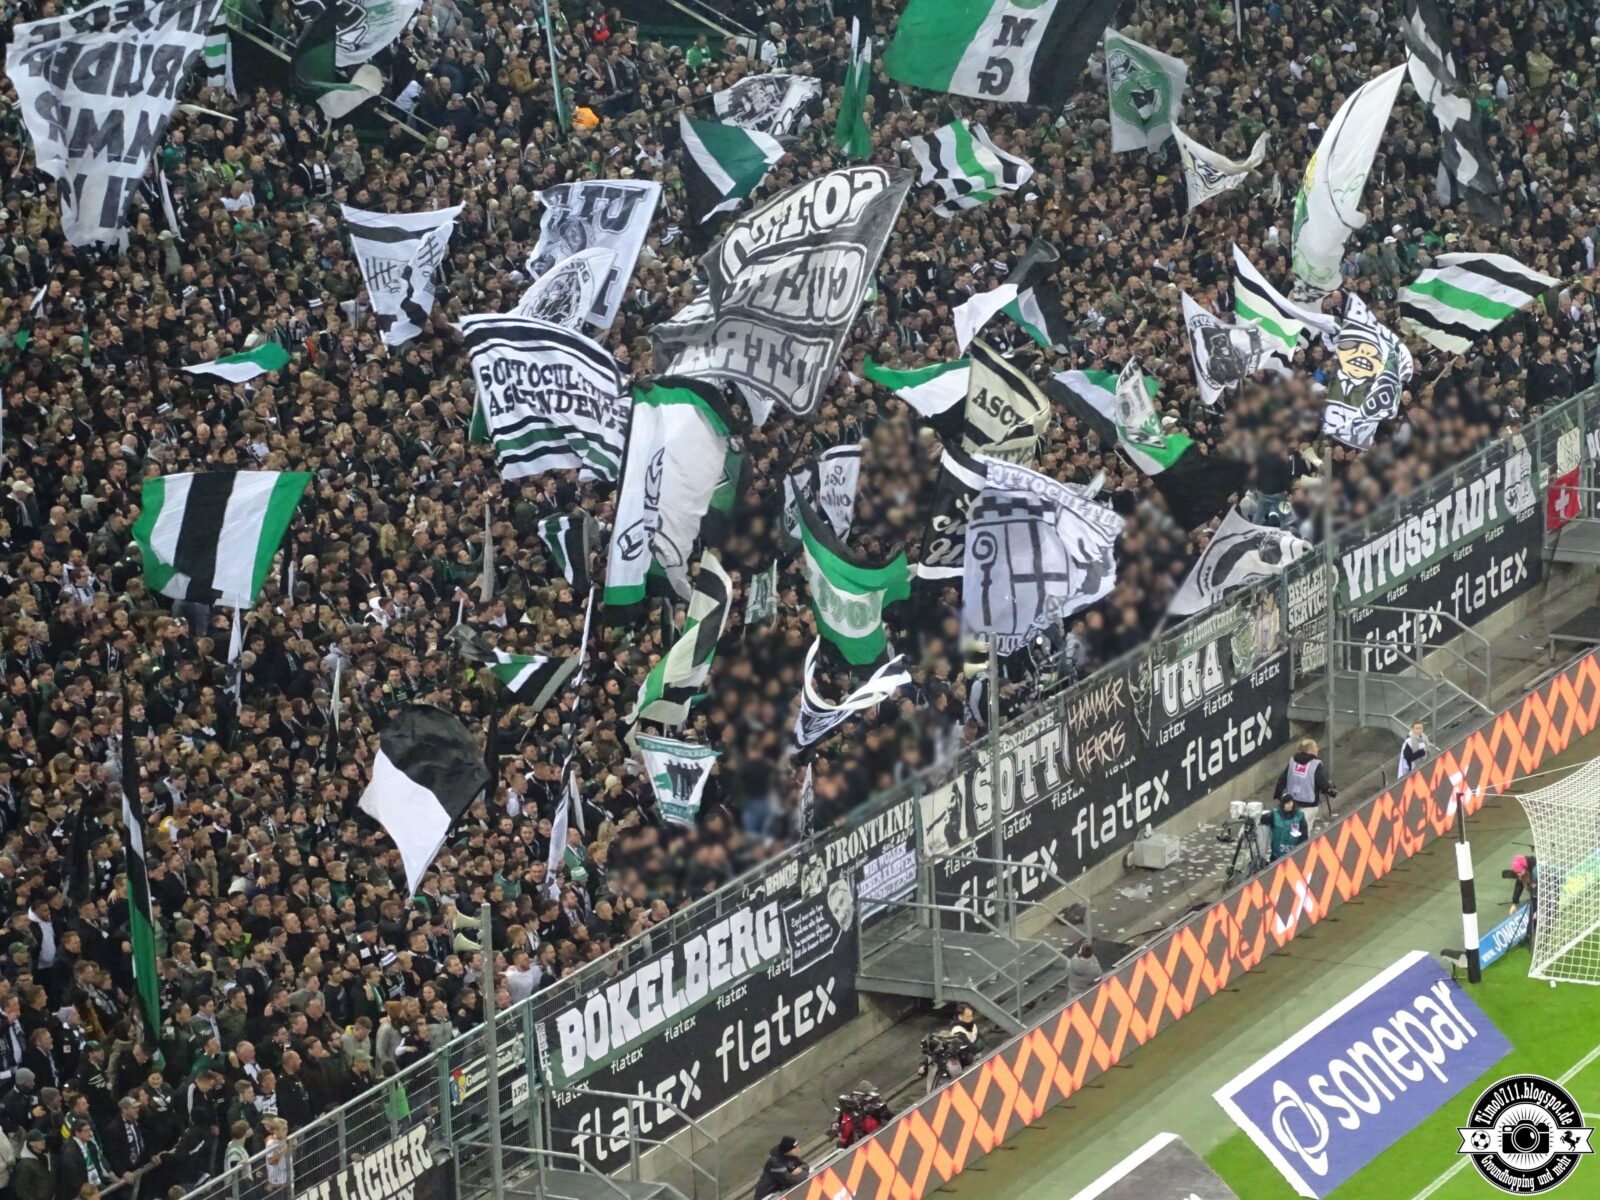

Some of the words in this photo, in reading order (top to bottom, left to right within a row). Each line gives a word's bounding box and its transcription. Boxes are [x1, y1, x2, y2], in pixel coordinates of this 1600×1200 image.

[1343, 468, 1500, 602] VITUSSTADT
[825, 797, 914, 872] FRONTLINE
[556, 901, 781, 1077] BÖKELBERG
[1308, 980, 1478, 1130] sonepar
